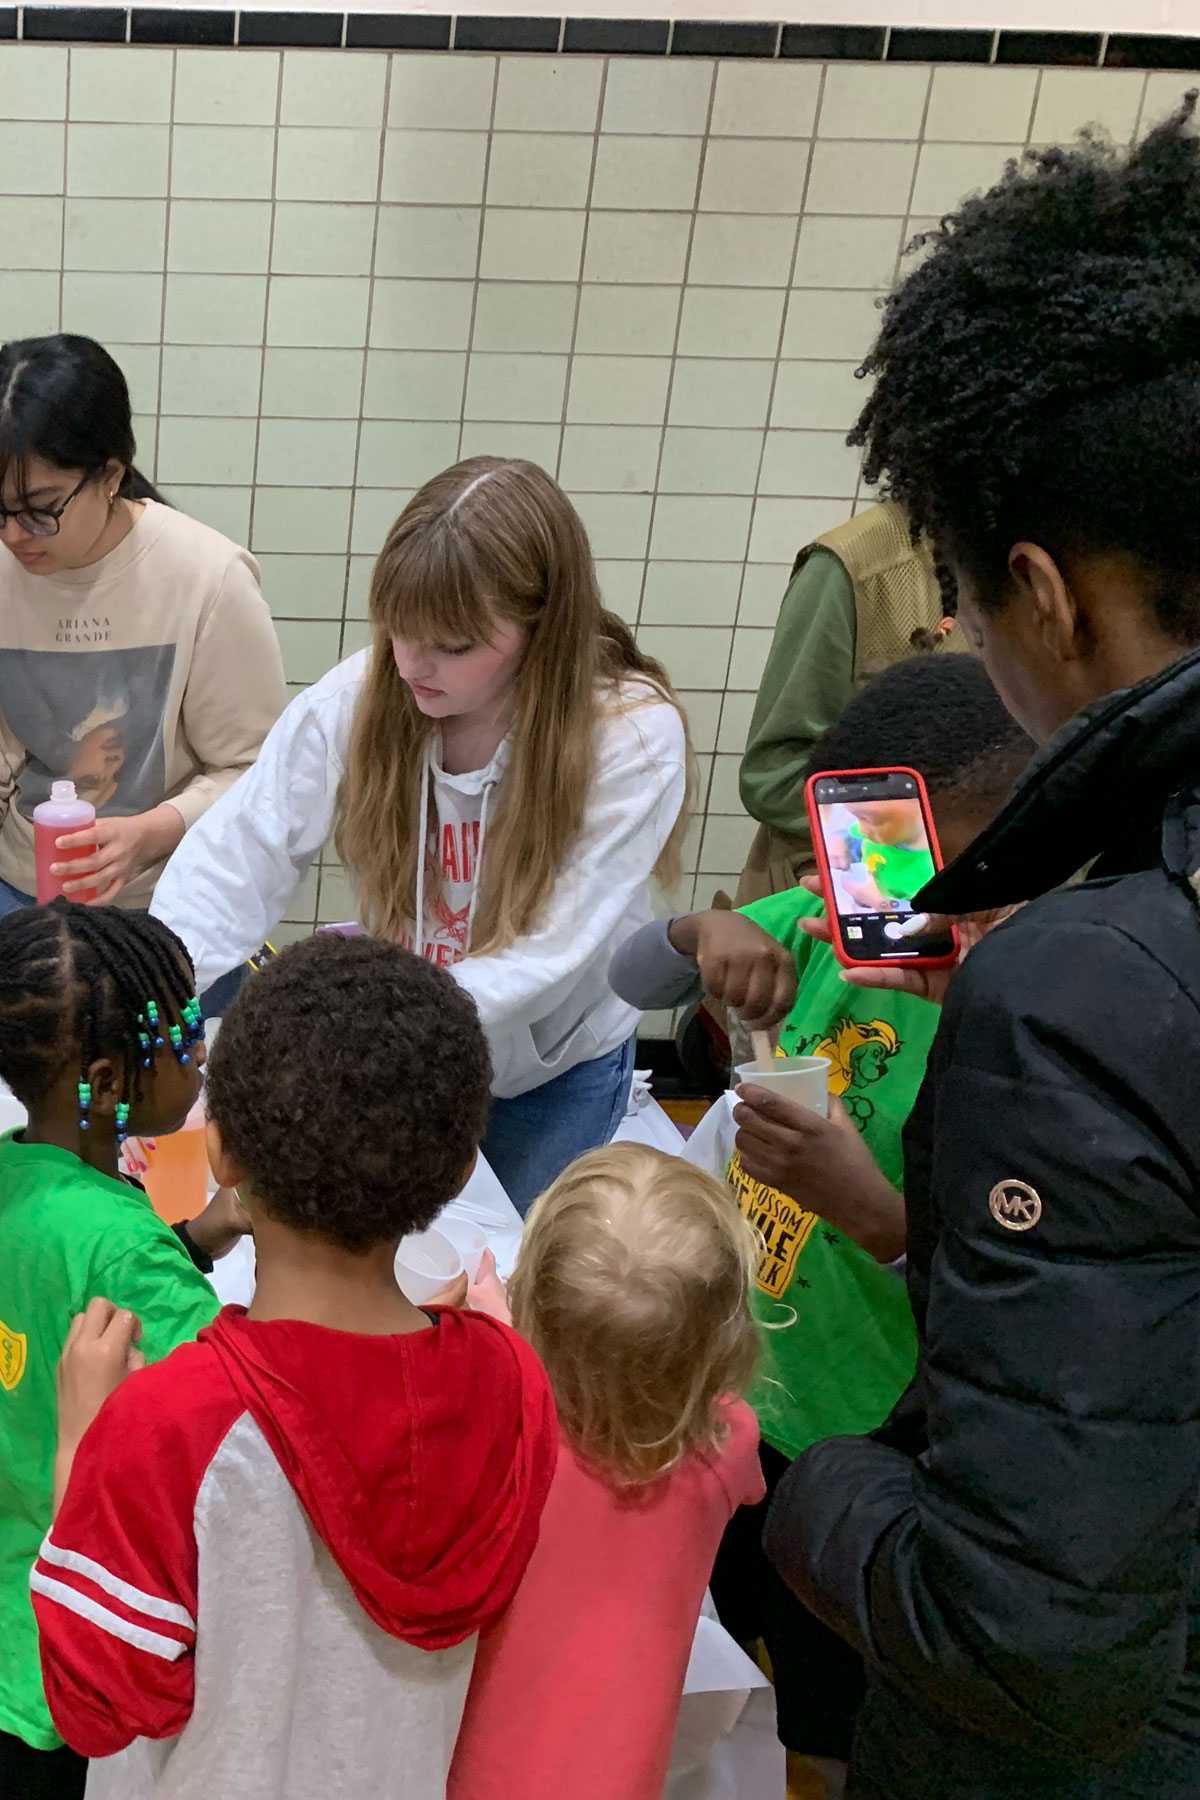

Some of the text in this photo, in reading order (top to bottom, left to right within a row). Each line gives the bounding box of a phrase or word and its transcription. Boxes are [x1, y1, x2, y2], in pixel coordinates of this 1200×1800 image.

[59, 617, 110, 629] ARIANA
[55, 631, 111, 642] GRANDE
[751, 1181, 805, 1234] OSSOM
[993, 1187, 1037, 1221] MK
